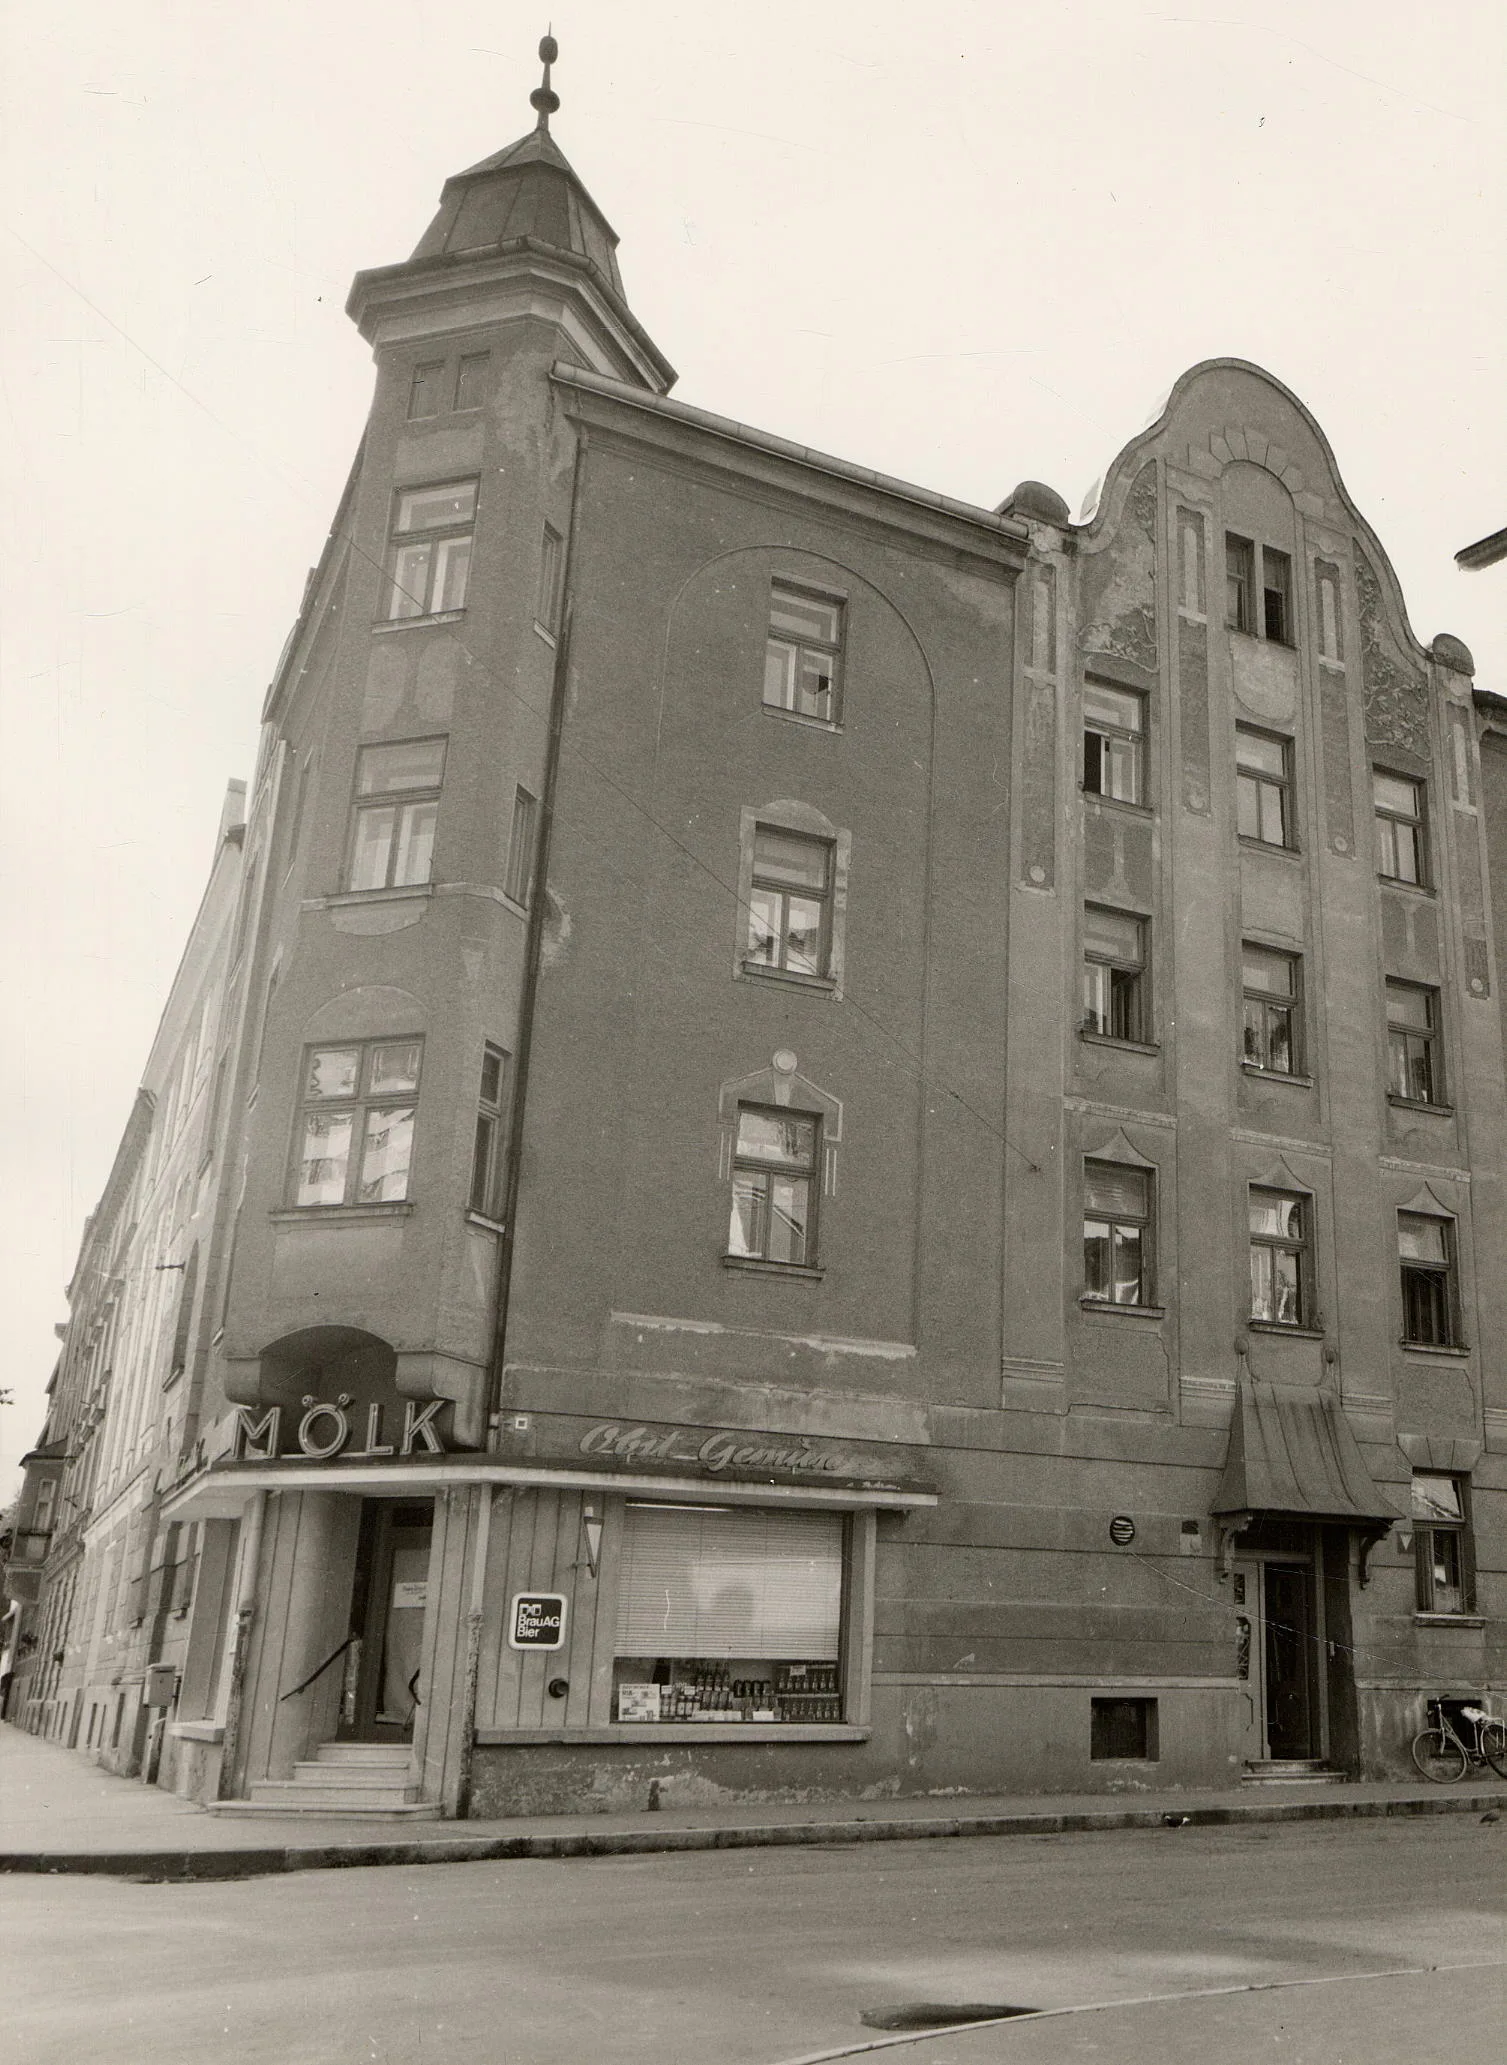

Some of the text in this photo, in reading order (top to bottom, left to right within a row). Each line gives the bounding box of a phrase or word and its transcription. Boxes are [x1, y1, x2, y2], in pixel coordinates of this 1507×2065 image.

[233, 1393, 445, 1458] MÖLK
[579, 1424, 680, 1458] Obst
[516, 1626, 540, 1638] Bier
